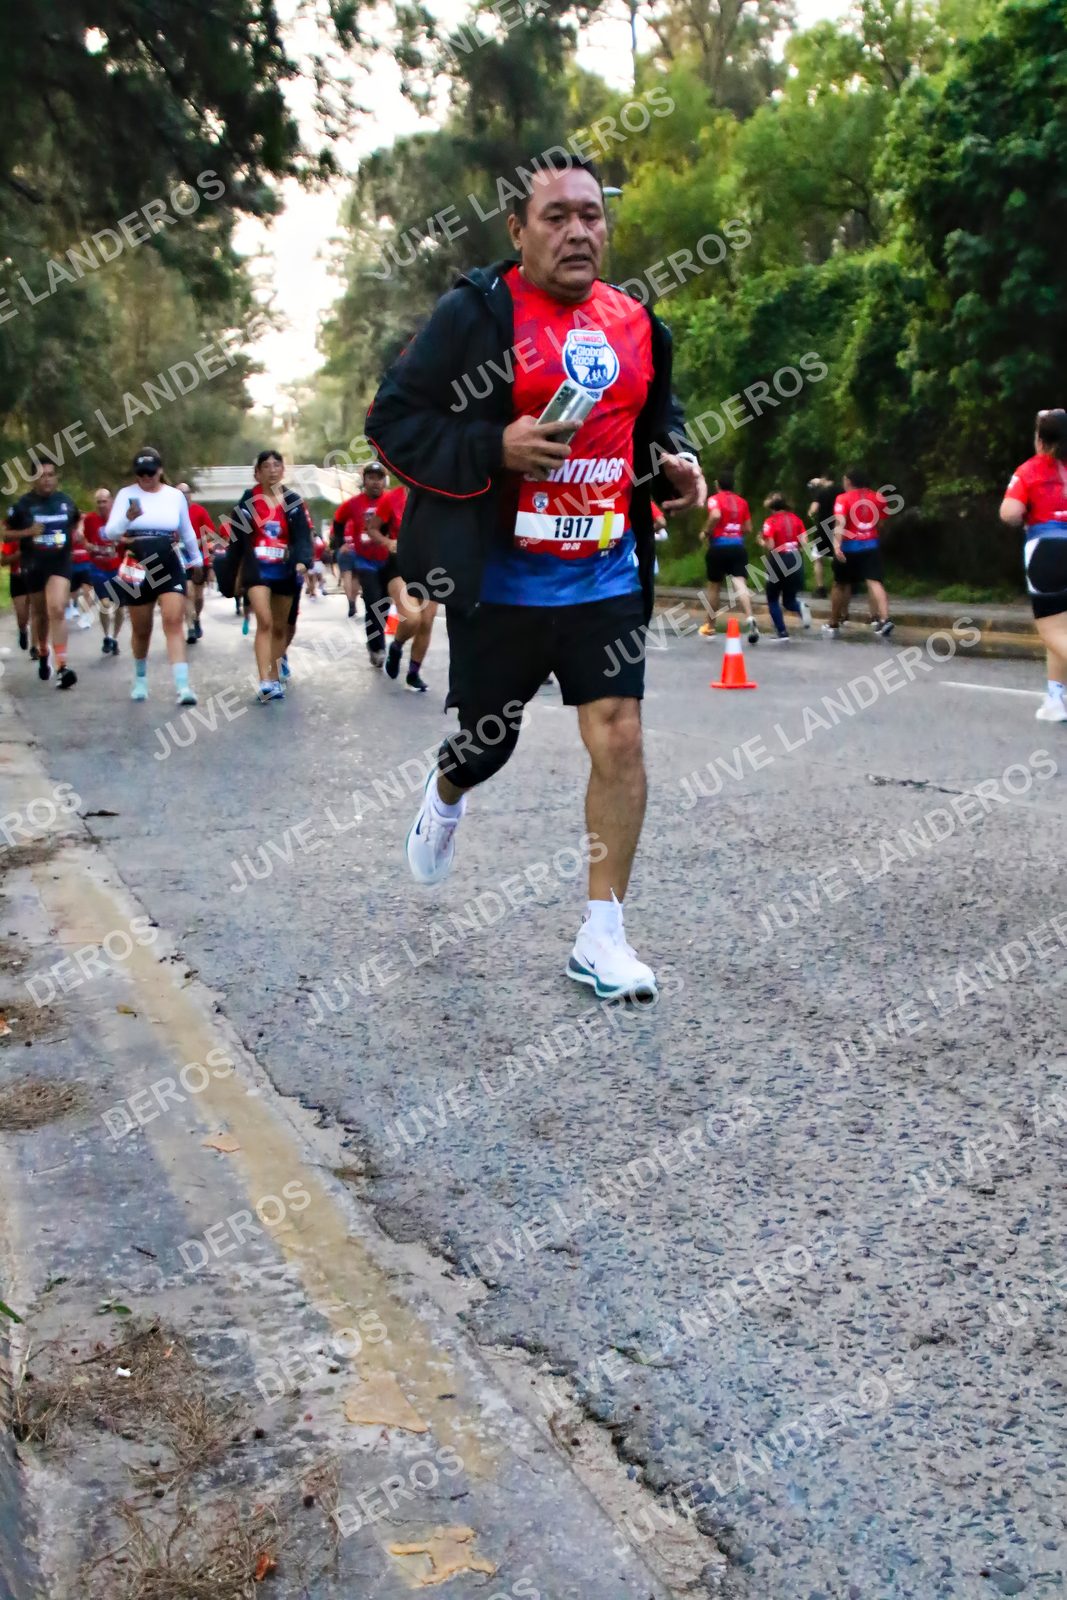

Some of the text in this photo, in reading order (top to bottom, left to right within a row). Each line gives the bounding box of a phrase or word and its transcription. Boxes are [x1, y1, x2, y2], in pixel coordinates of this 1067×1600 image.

[576, 345, 604, 357] Global
[572, 355, 595, 366] Race
[554, 517, 594, 539] 1917
